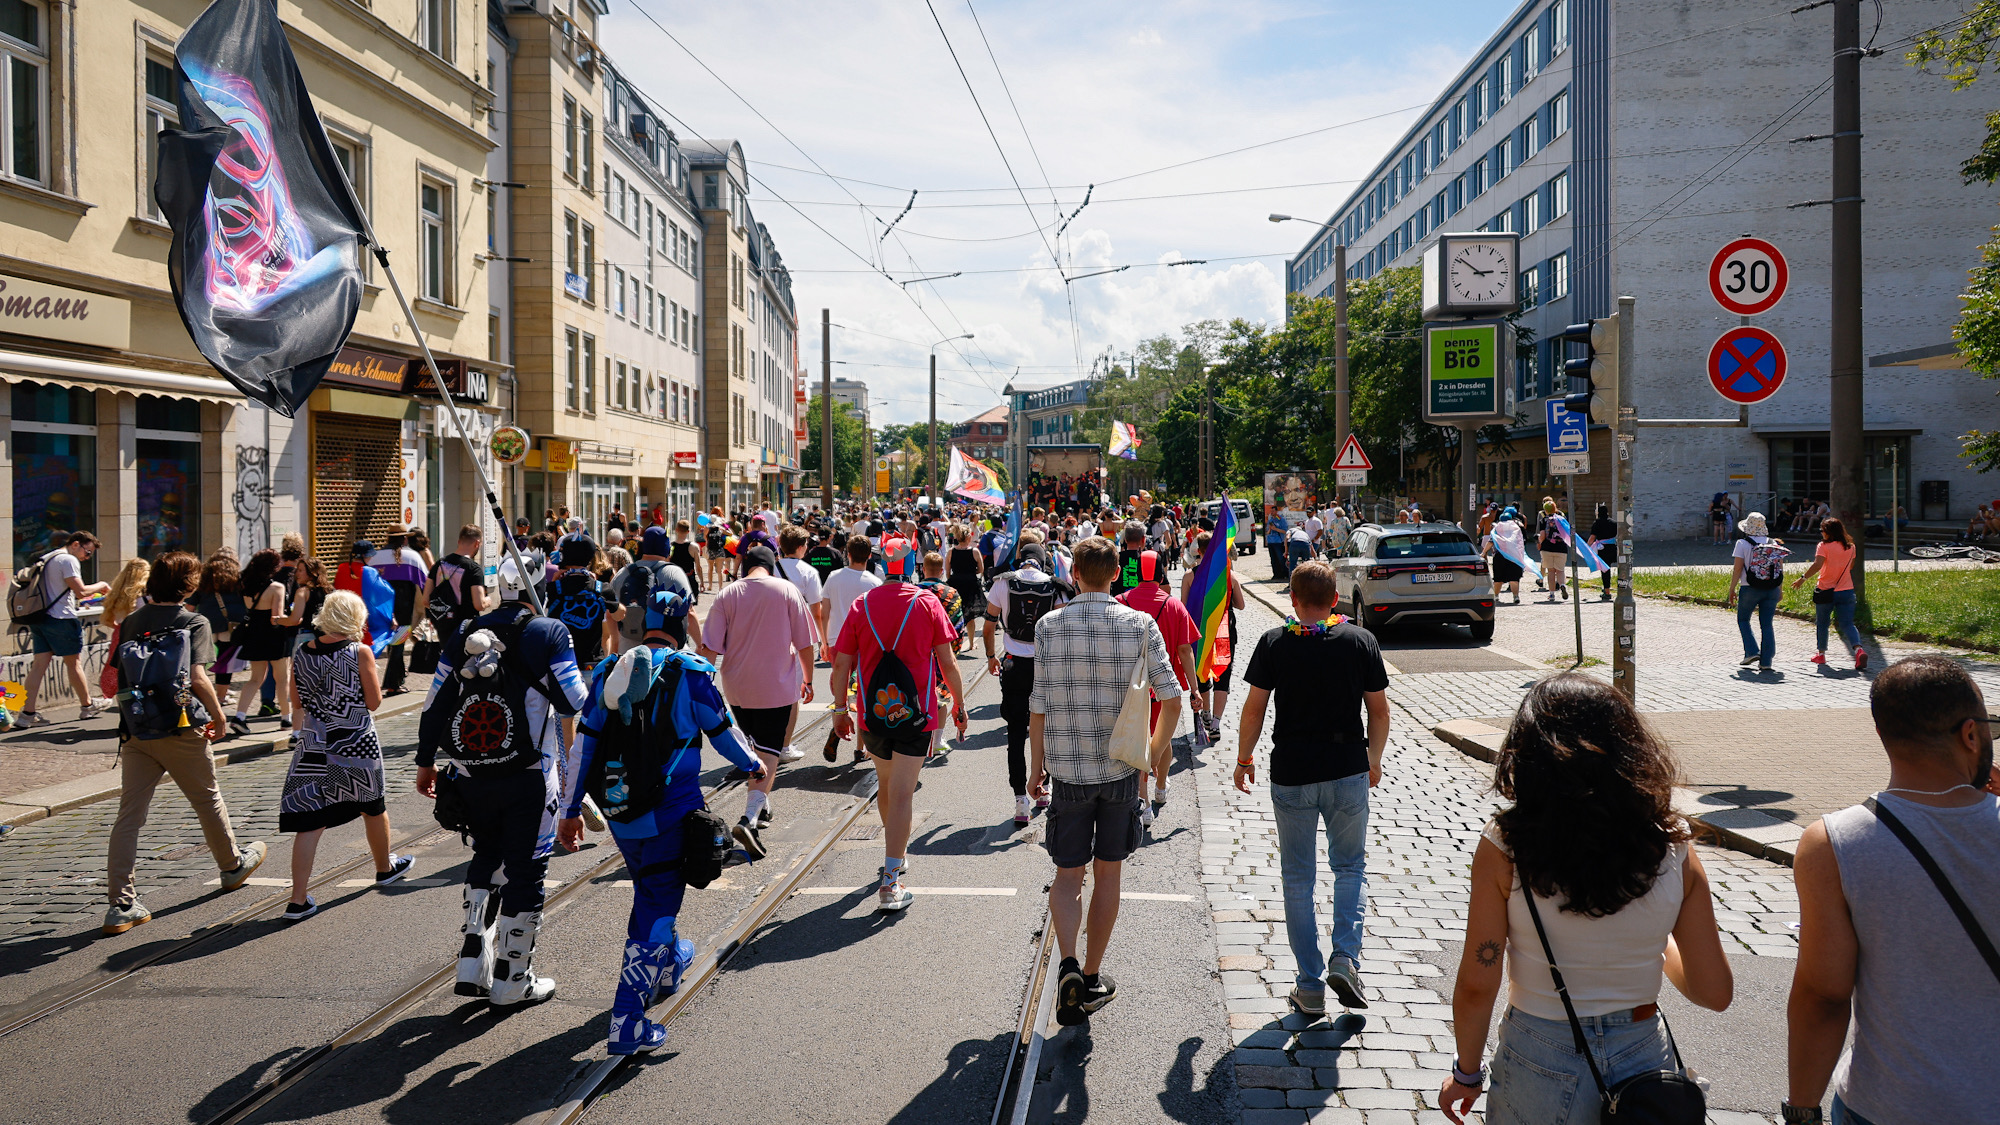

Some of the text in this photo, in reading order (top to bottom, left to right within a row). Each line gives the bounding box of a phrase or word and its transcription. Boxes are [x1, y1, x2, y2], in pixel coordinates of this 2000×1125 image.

[1725, 260, 1770, 293] 30
[360, 356, 405, 384] Schmuck
[1444, 348, 1480, 369] Bio
[437, 404, 481, 440] PIZZA
[1553, 402, 1570, 424] P
[1129, 557, 1139, 587] BLUE
